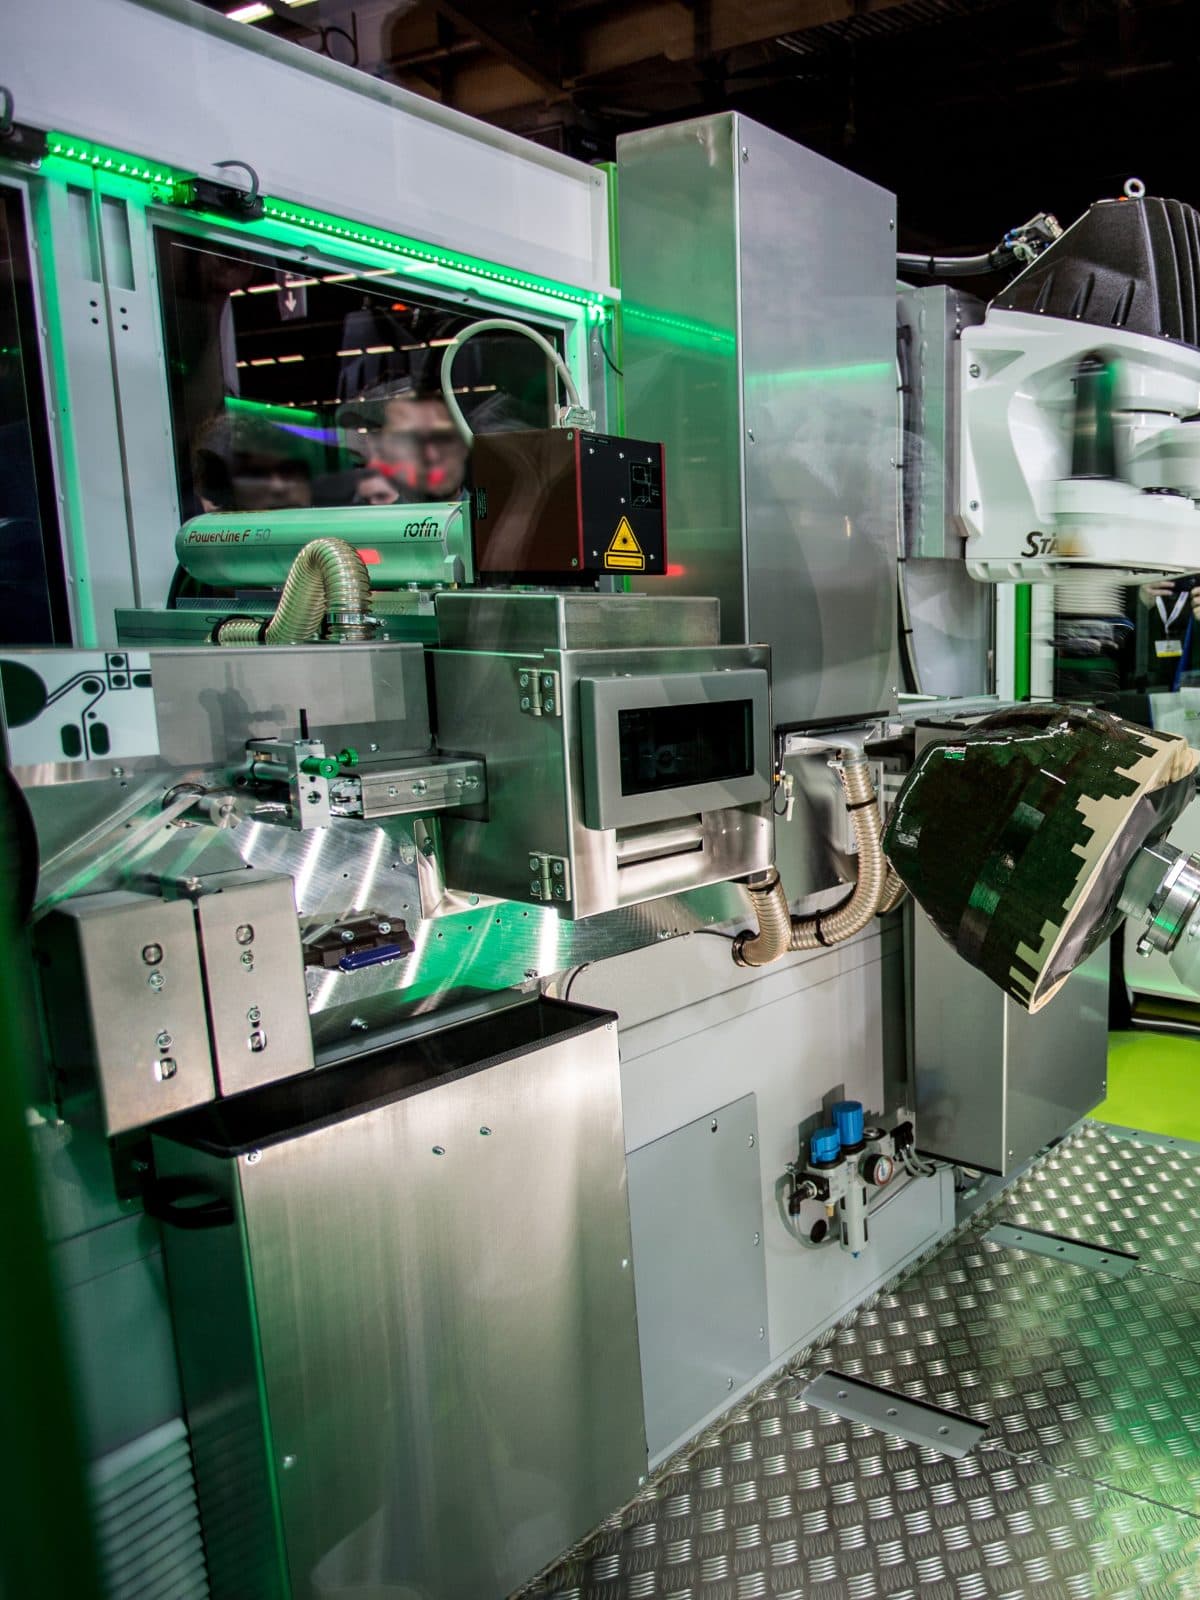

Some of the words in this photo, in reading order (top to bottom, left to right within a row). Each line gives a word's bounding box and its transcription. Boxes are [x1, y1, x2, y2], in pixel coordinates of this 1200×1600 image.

[242, 529, 252, 543] F
[255, 528, 272, 542] 50
[403, 516, 439, 538] rofin
